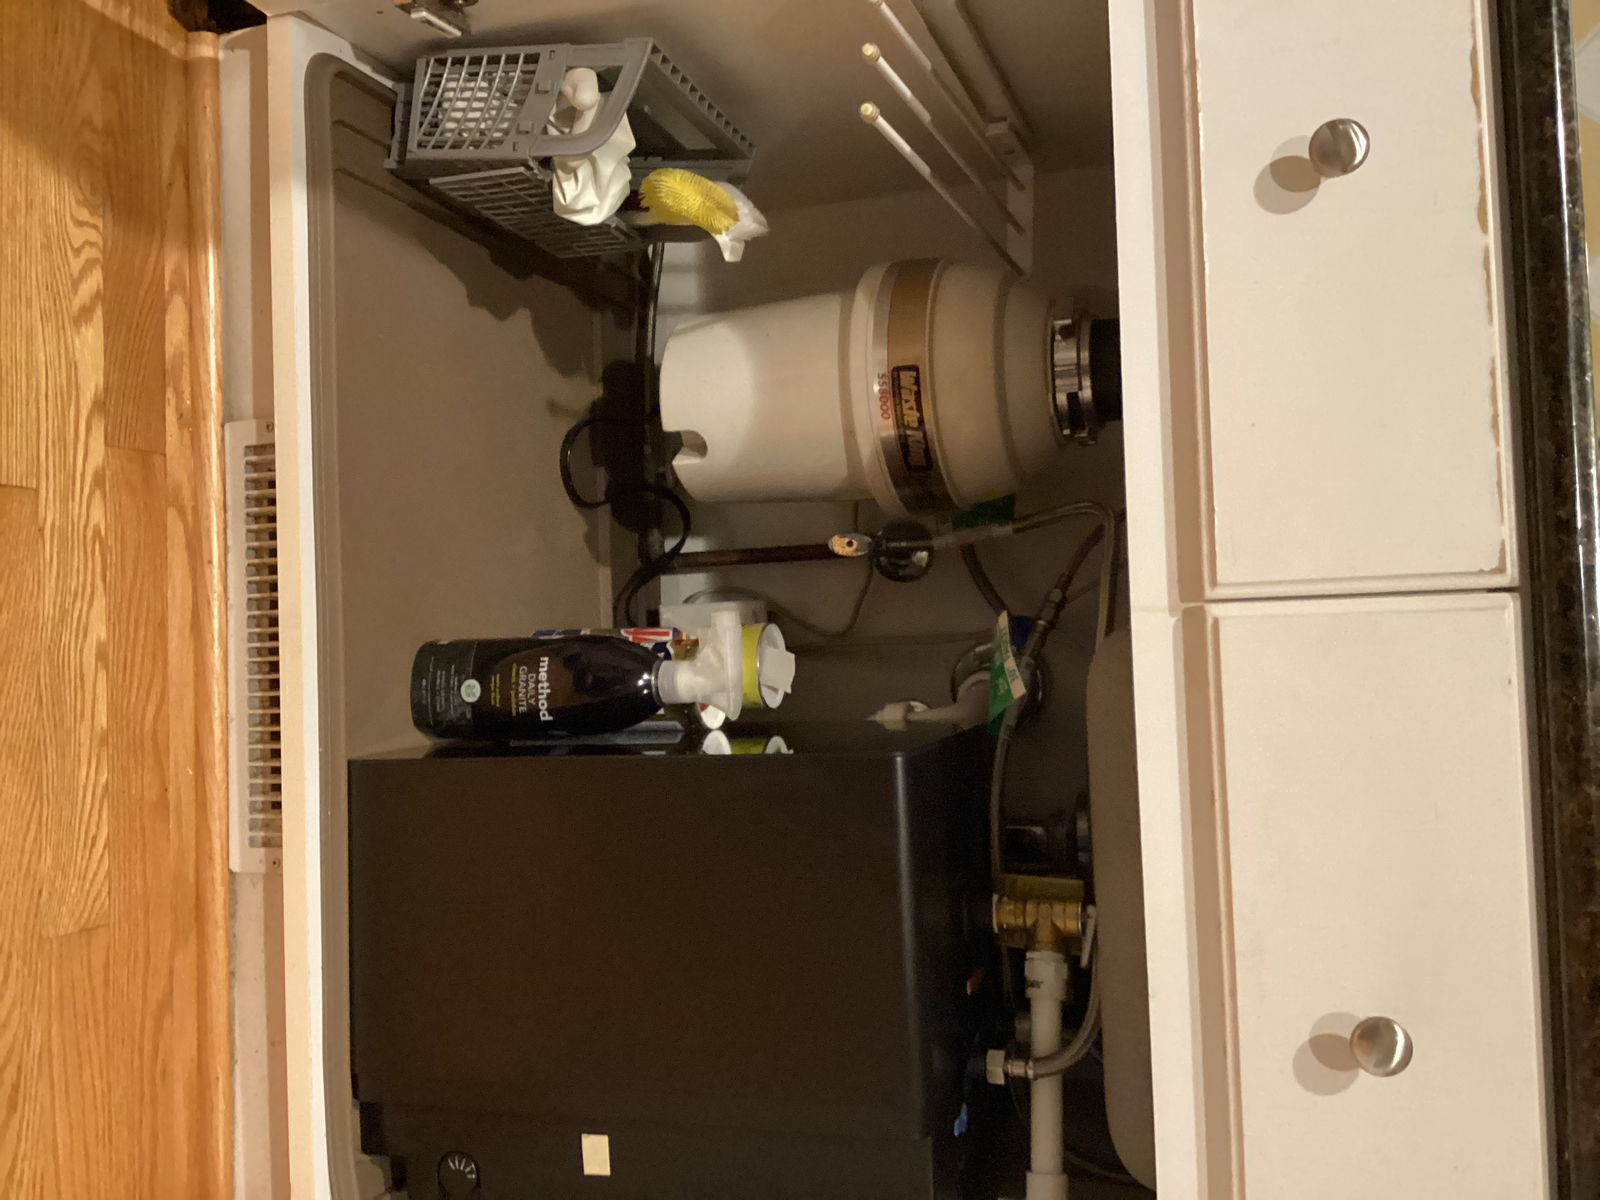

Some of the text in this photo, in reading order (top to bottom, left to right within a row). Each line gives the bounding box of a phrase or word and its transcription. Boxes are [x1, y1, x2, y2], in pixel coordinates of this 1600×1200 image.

[877, 373, 891, 420] SS8000
[899, 371, 920, 427] Waste
[518, 665, 528, 714] GRANITE
[527, 673, 536, 706] DAILY
[537, 656, 554, 722] method
